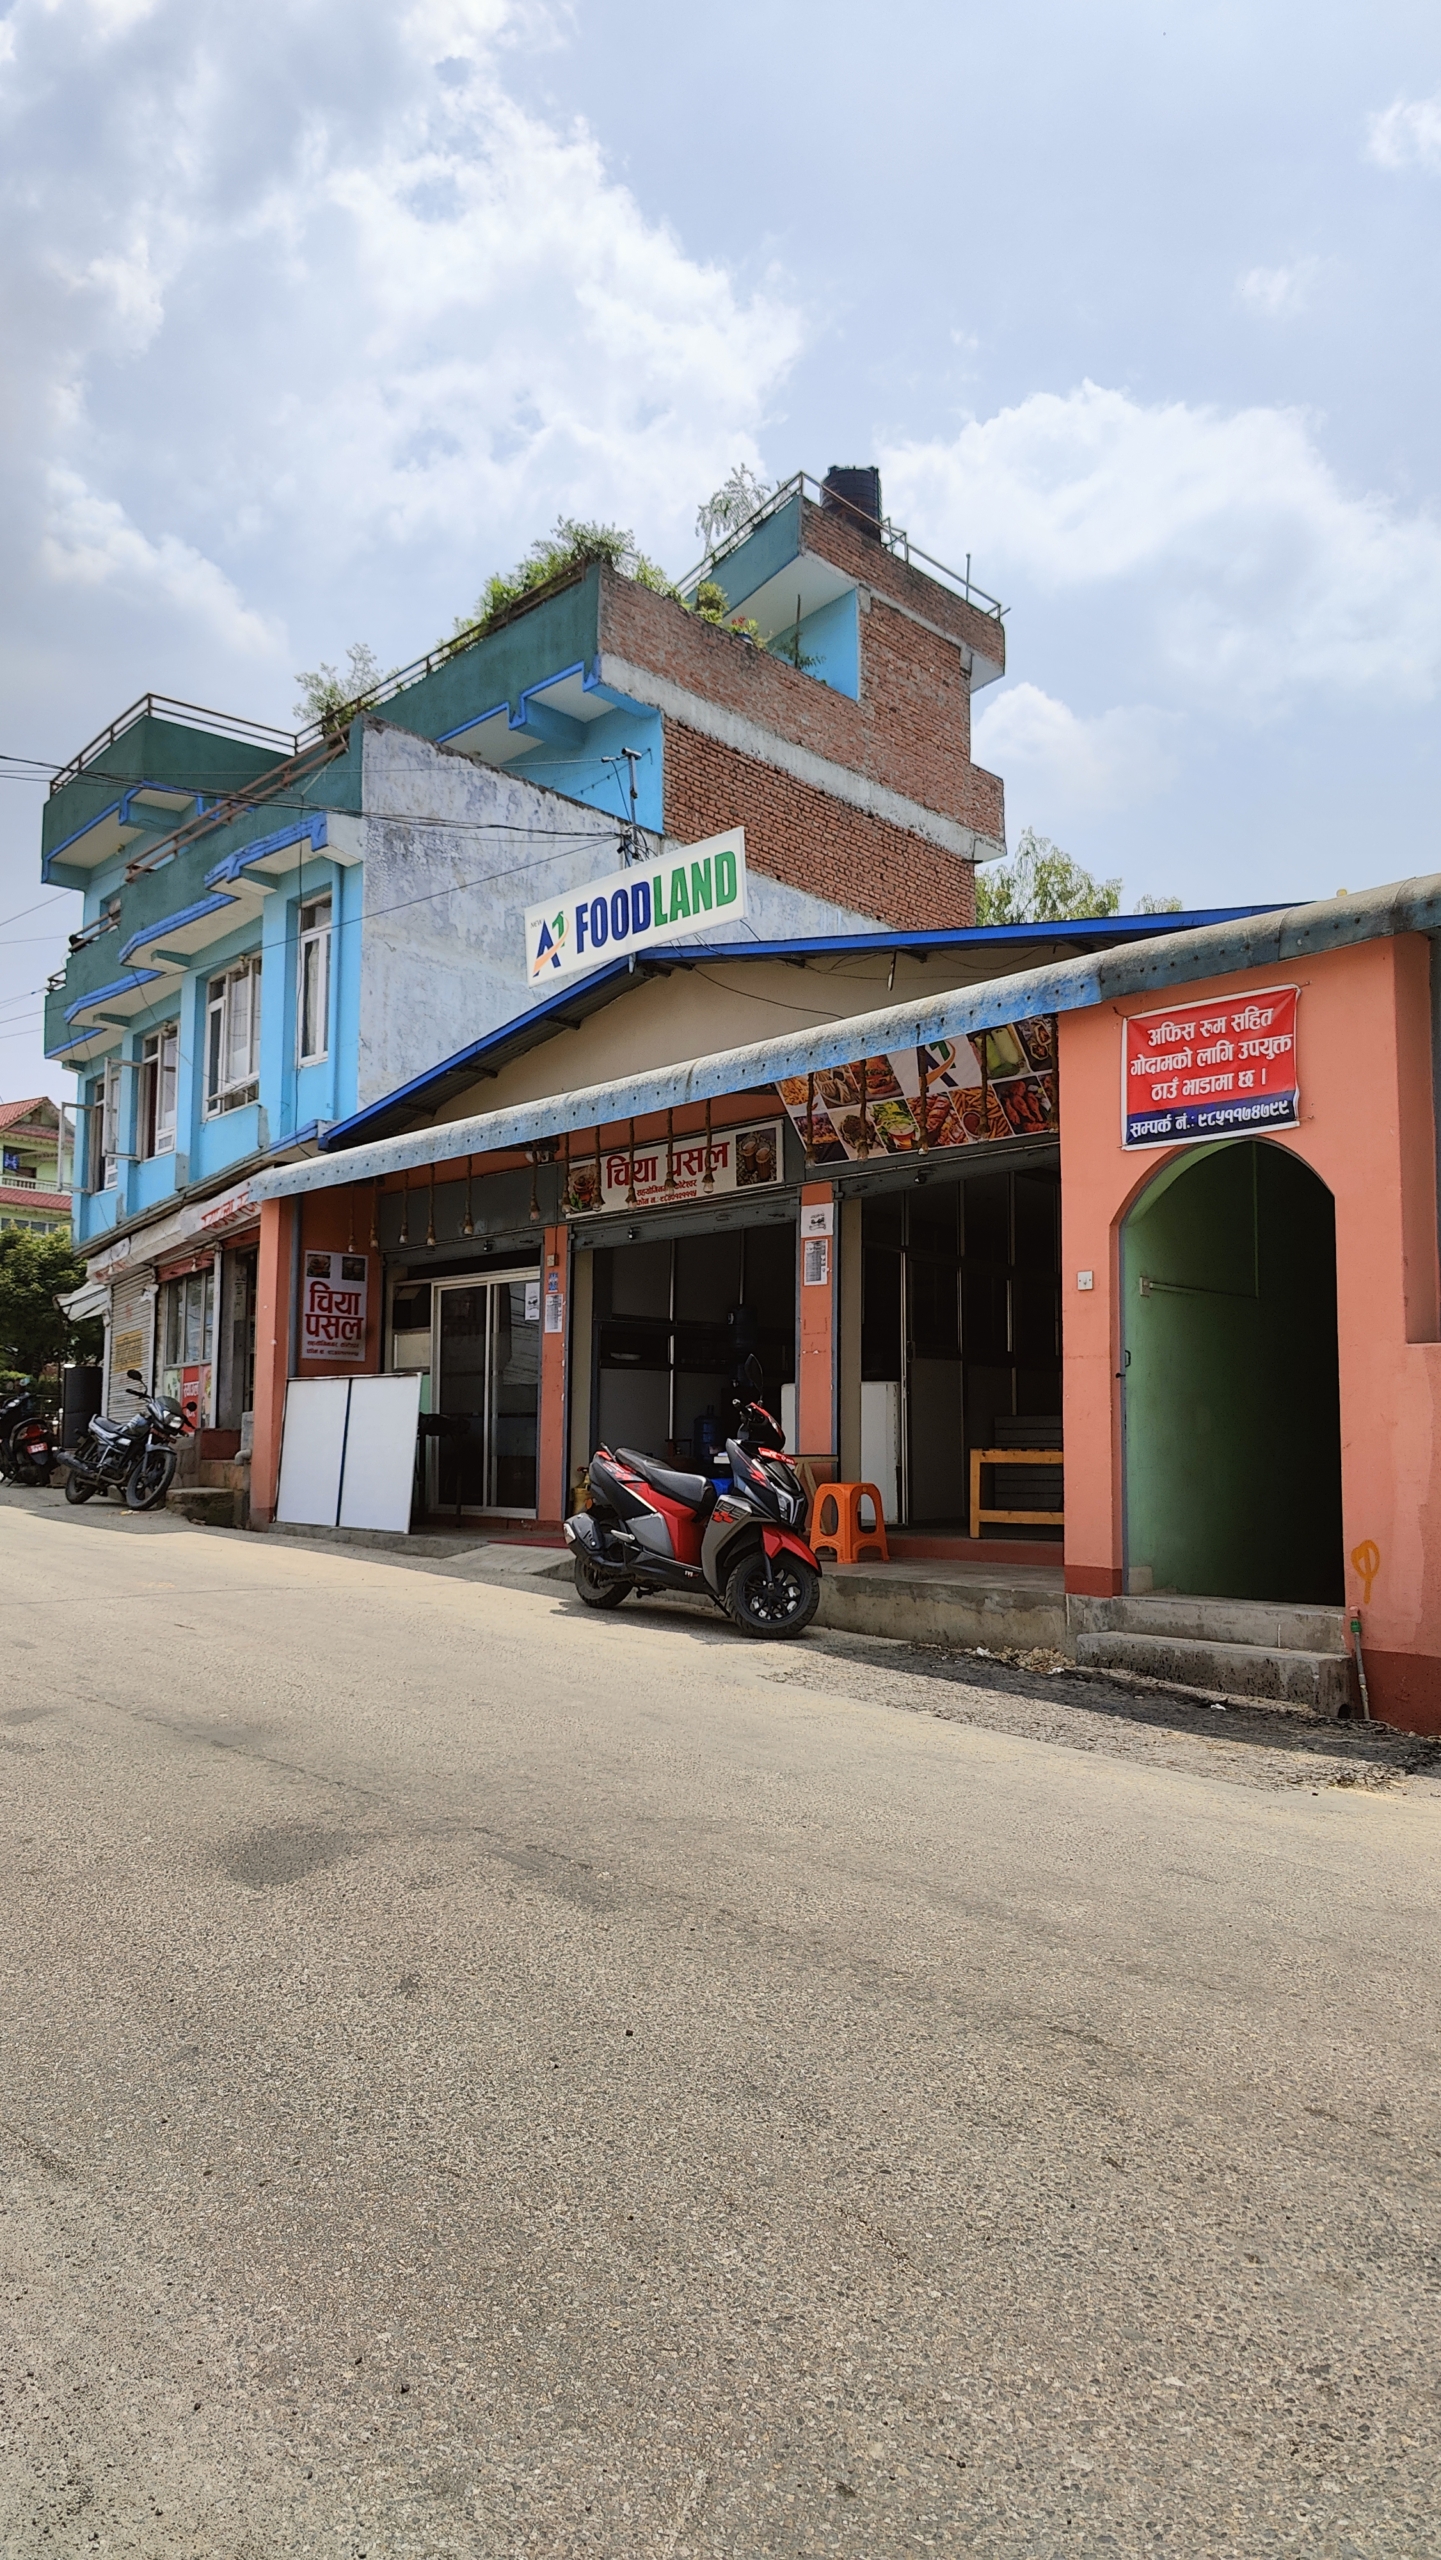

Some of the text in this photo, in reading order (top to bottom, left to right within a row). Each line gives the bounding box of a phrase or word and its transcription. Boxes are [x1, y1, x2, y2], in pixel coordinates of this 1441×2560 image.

[576, 851, 737, 954] FOODLAND
[1147, 1005, 1274, 1047] अफिस रूम सहित
[1130, 1034, 1293, 1076] गोदामको लागि उपयुक्त
[1151, 1076, 1179, 1101] ठाउँ
[1182, 1073, 1235, 1096] भाडामा
[1238, 1070, 1255, 1088] छ
[1130, 1114, 1173, 1138] सम्पर्क
[1198, 1101, 1290, 1127] ९८५११७४७९९
[606, 1142, 730, 1189] चिया पसल
[310, 1281, 361, 1316] चिया
[305, 1314, 364, 1340] पसल
